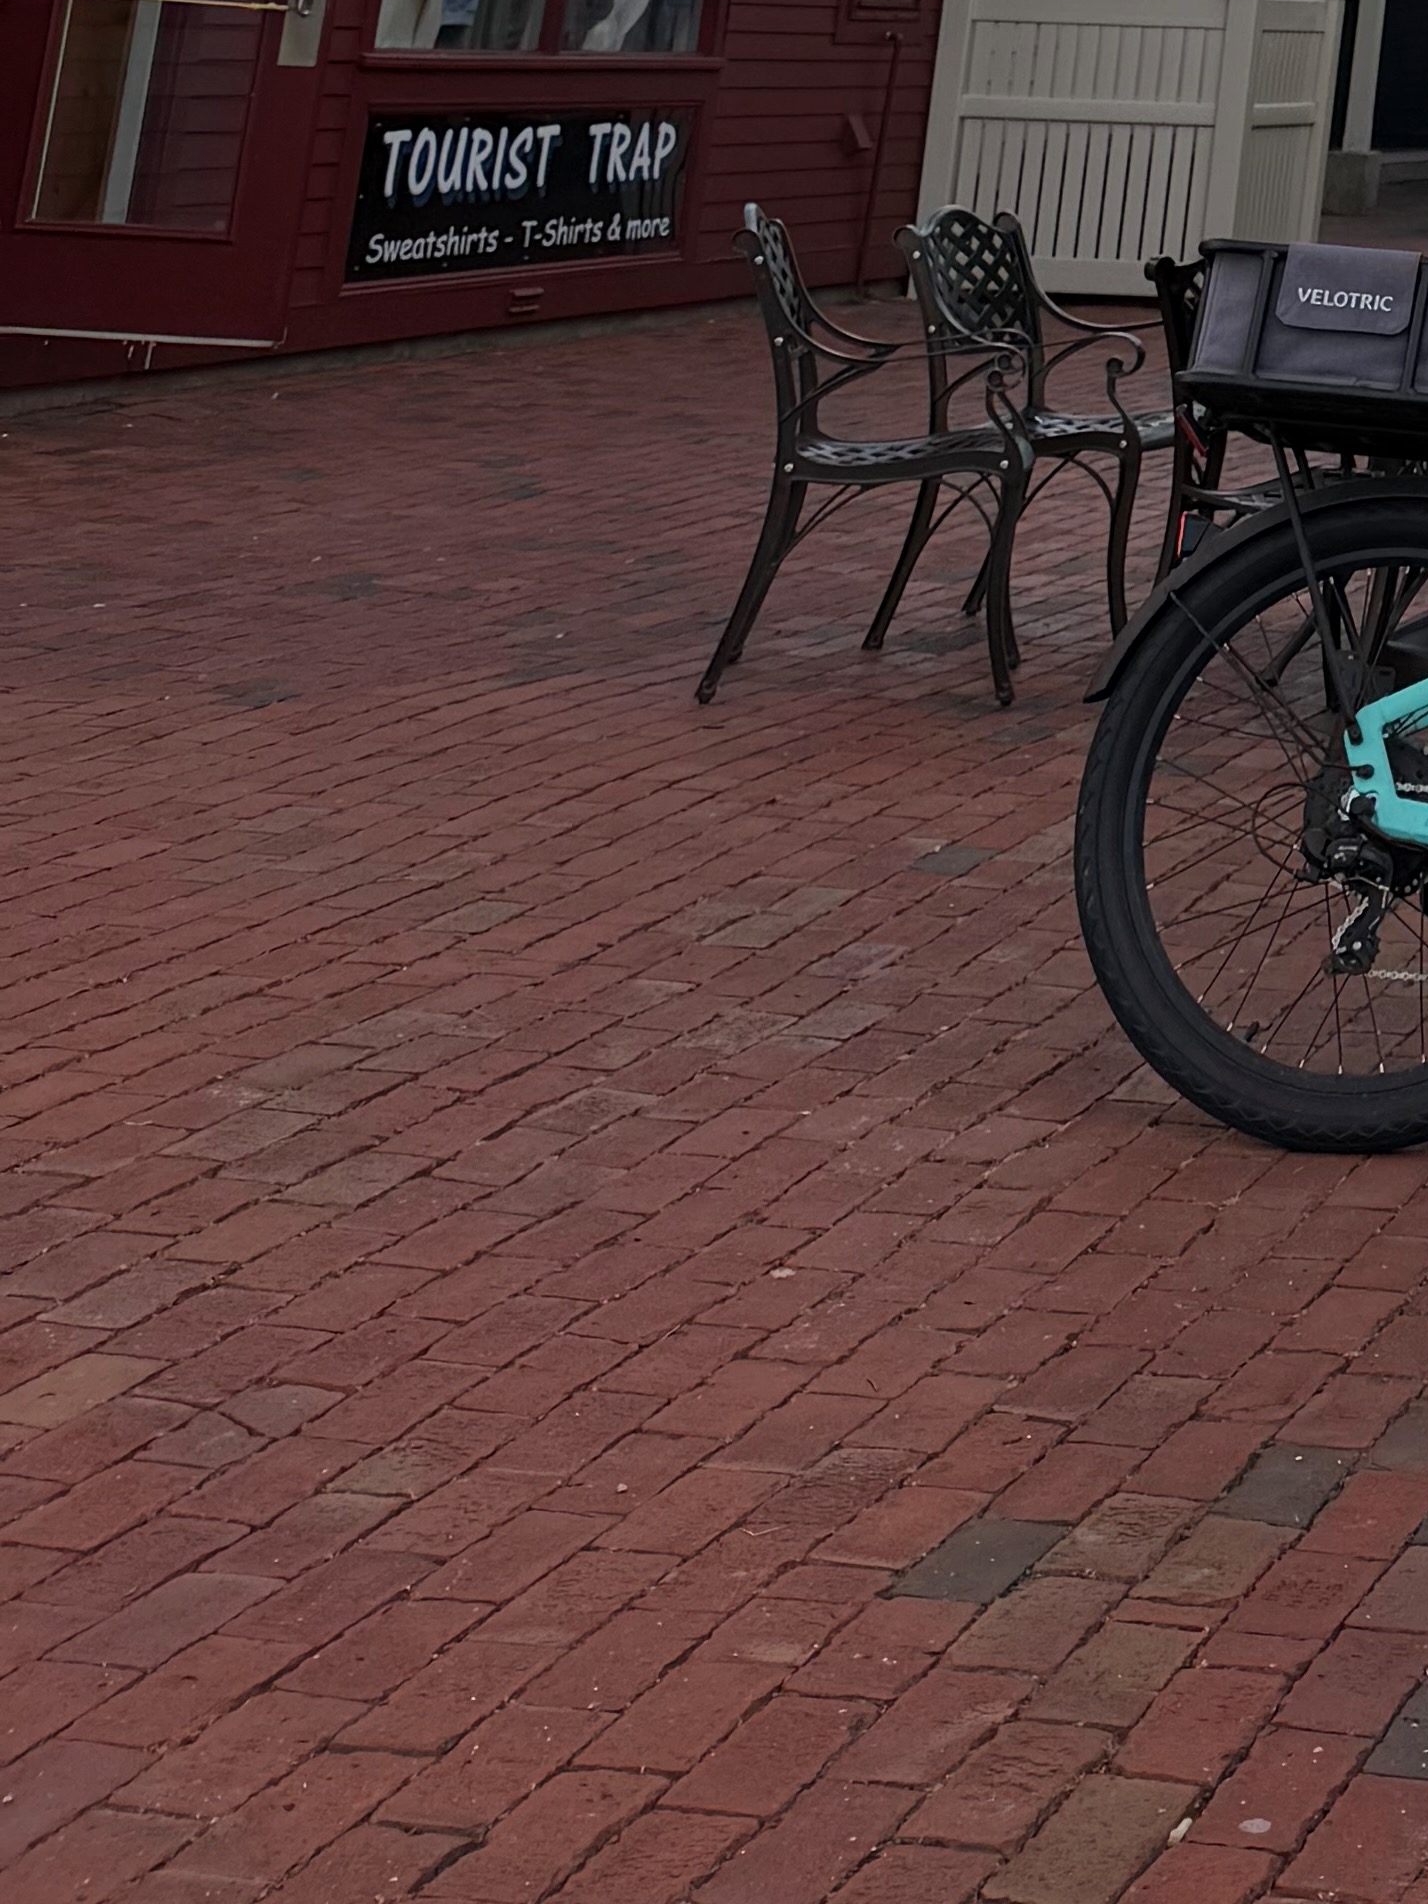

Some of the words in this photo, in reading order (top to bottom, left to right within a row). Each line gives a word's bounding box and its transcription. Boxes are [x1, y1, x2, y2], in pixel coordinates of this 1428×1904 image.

[383, 123, 562, 198] TOURIST
[588, 121, 677, 185] TRAP
[365, 224, 500, 265] Sweatshirts
[521, 215, 604, 249] T-Shirts
[606, 212, 622, 242] &
[624, 215, 671, 242] more
[1297, 287, 1394, 313] VELOTRIC
